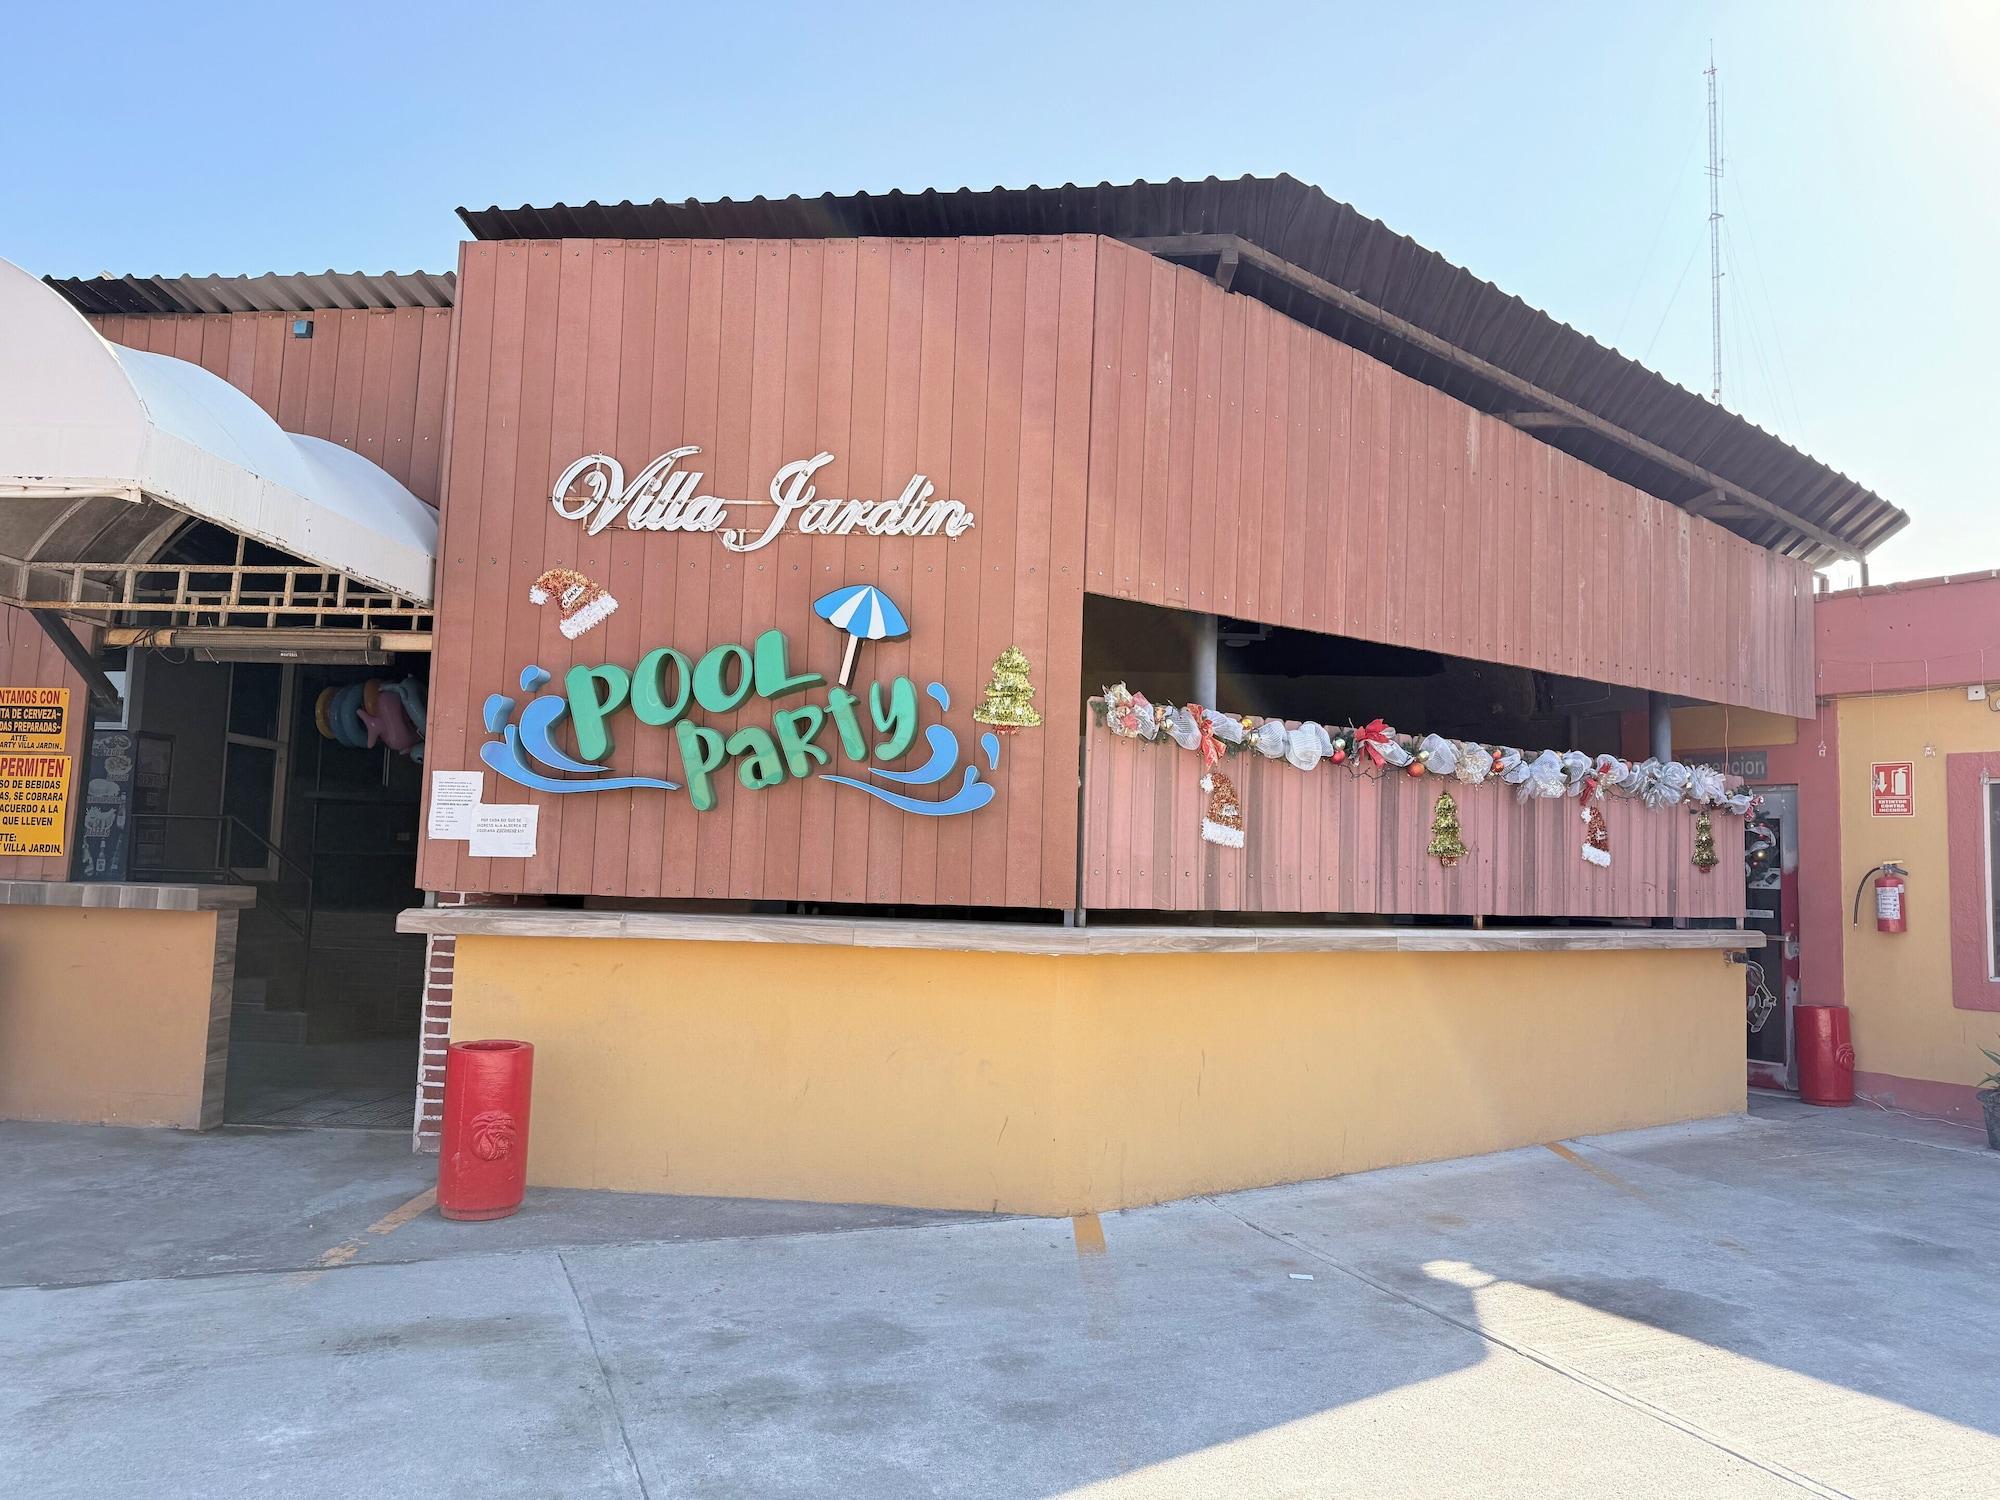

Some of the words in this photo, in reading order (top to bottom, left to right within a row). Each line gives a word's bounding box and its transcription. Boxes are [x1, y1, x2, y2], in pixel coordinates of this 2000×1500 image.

[551, 446, 727, 536] Villa
[40, 690, 61, 704] CON
[565, 629, 827, 762] POOL
[0, 708, 10, 719] TA
[12, 708, 22, 719] DE
[10, 734, 28, 742] ATTE:
[0, 758, 64, 777] PERMITEN
[12, 780, 23, 789] DE
[25, 780, 61, 789] BEBIDAS
[13, 792, 24, 801] SE
[25, 792, 63, 801] COBRARA
[0, 803, 38, 813] ACUERDO
[40, 804, 46, 813] A
[48, 805, 59, 813] LA
[2, 816, 19, 826] QUE
[21, 817, 53, 826] LLEVEN
[3, 843, 26, 852] VILLA
